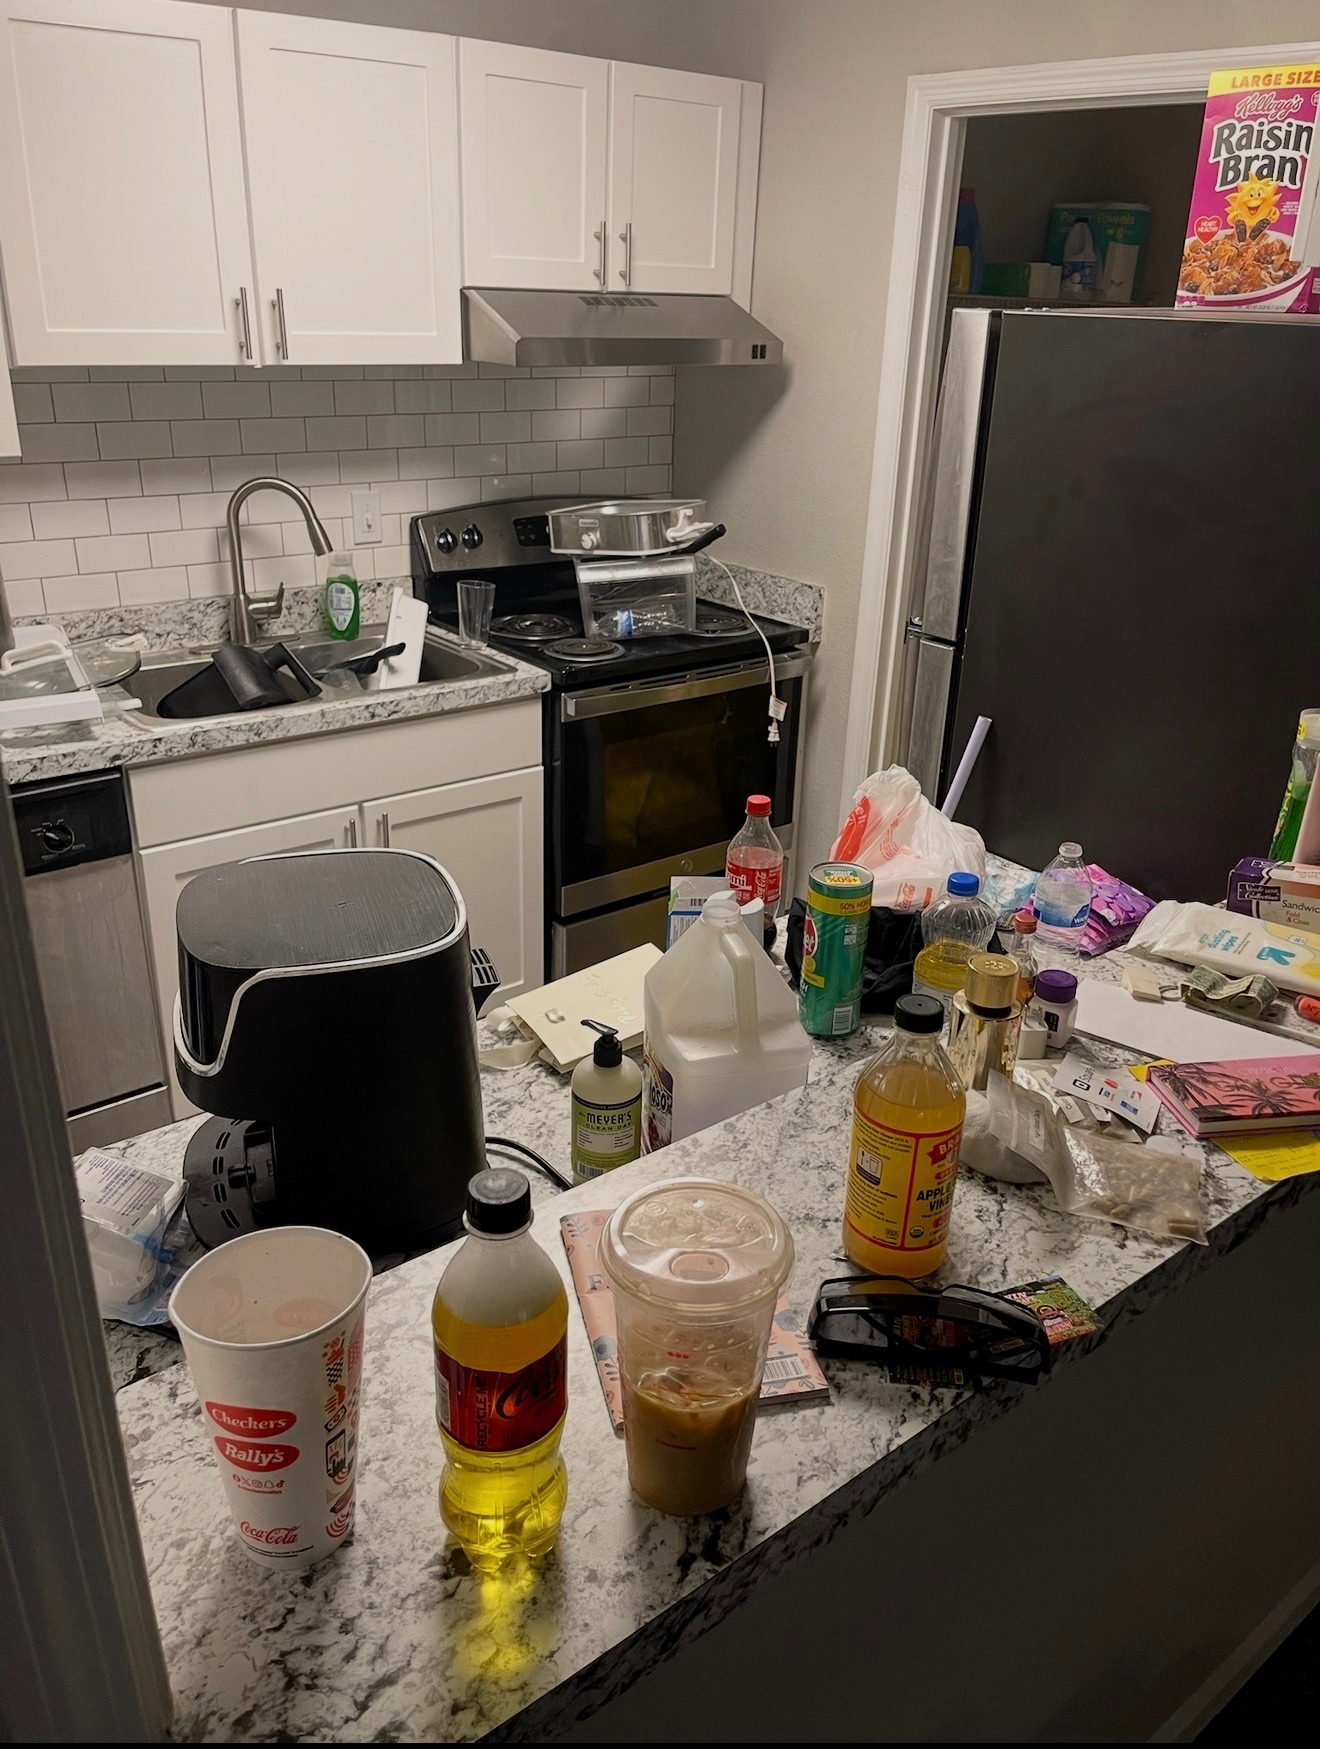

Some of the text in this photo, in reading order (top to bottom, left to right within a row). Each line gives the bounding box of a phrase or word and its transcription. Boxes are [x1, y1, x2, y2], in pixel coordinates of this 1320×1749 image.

[1231, 70, 1320, 89] LARGE SIZE
[1235, 92, 1303, 120] Kellogg's
[1212, 119, 1313, 160] Raisin
[1218, 154, 1299, 188] Bran
[585, 1122, 633, 1131] CLEAN DAY
[586, 1111, 632, 1126] MEYER'S
[916, 1183, 951, 1201] APPLE
[212, 1408, 287, 1430] Checkers
[476, 1397, 488, 1447] RECYCLE
[225, 1443, 284, 1467] Rally's
[240, 1521, 302, 1546] Coca-Cola
